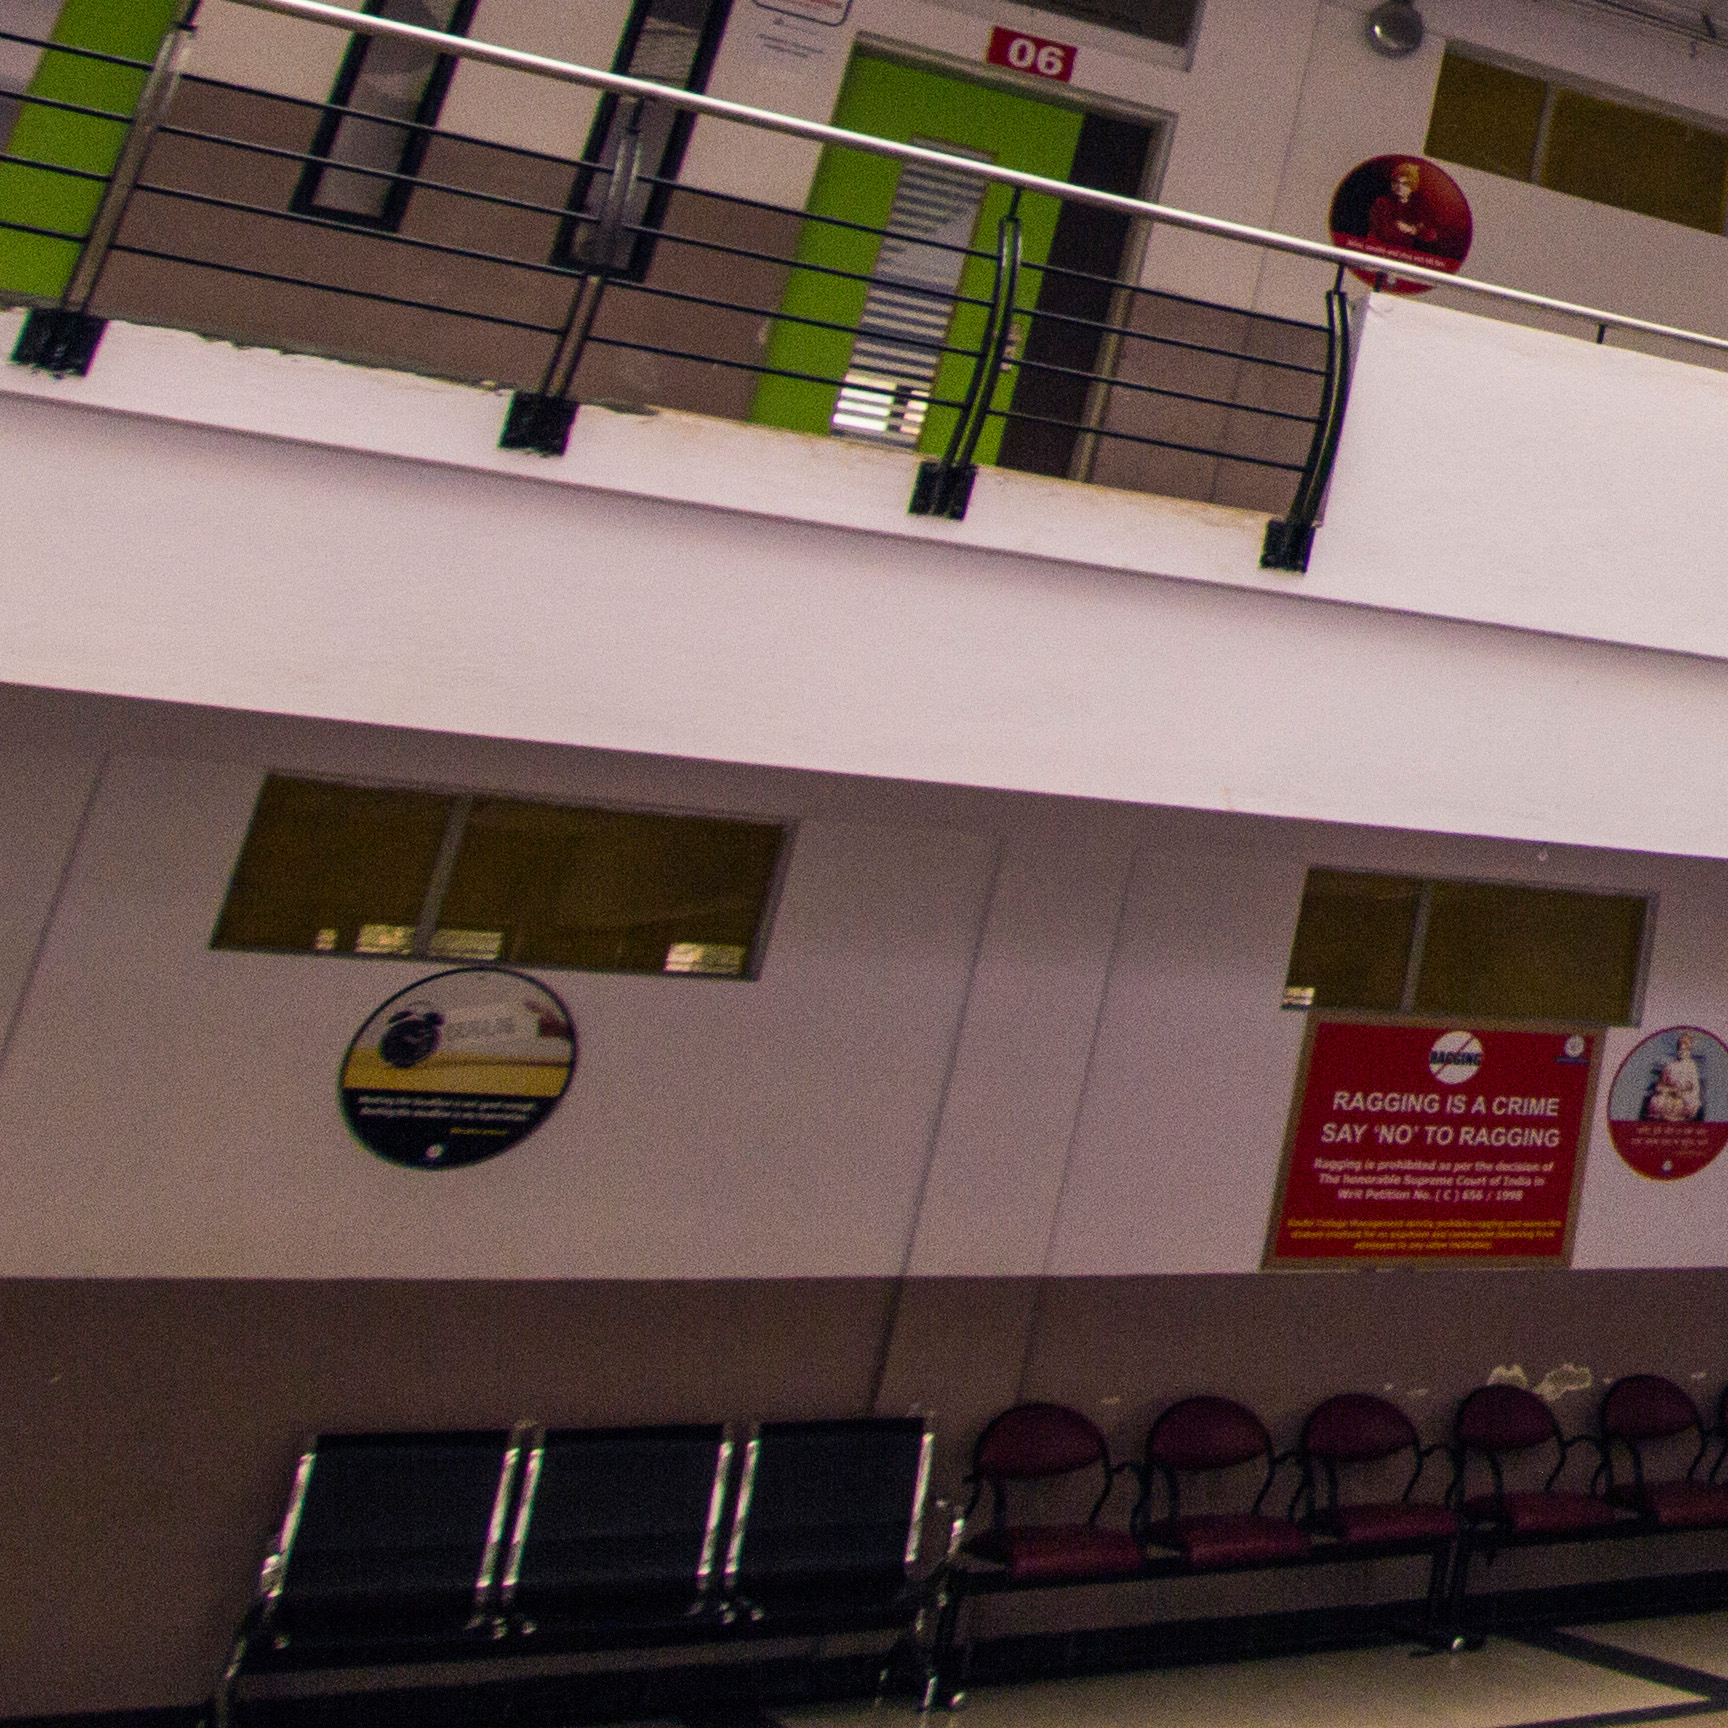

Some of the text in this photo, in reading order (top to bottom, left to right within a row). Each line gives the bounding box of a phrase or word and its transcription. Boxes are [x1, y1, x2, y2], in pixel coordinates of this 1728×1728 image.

[1008, 37, 1066, 76] 06
[1333, 1090, 1560, 1117] RAGGING IS A CRIME
[1321, 1122, 1368, 1144] SAY
[1424, 1124, 1454, 1145] TO
[1458, 1125, 1561, 1148] RAGGING
[1313, 1156, 1362, 1172] Ragging
[1376, 1158, 1437, 1173] prohibited
[1452, 1161, 1474, 1174] per
[1474, 1160, 1494, 1172] the
[1494, 1159, 1540, 1172] decision
[1541, 1160, 1556, 1172] of
[1319, 1172, 1341, 1185] The
[1402, 1173, 1454, 1188] Supreme
[1455, 1174, 1488, 1186] Court
[1488, 1174, 1502, 1186] of
[1502, 1175, 1532, 1187] India
[1533, 1175, 1546, 1187] in
[1337, 1187, 1364, 1200] Writ
[1364, 1187, 1411, 1200] Petition
